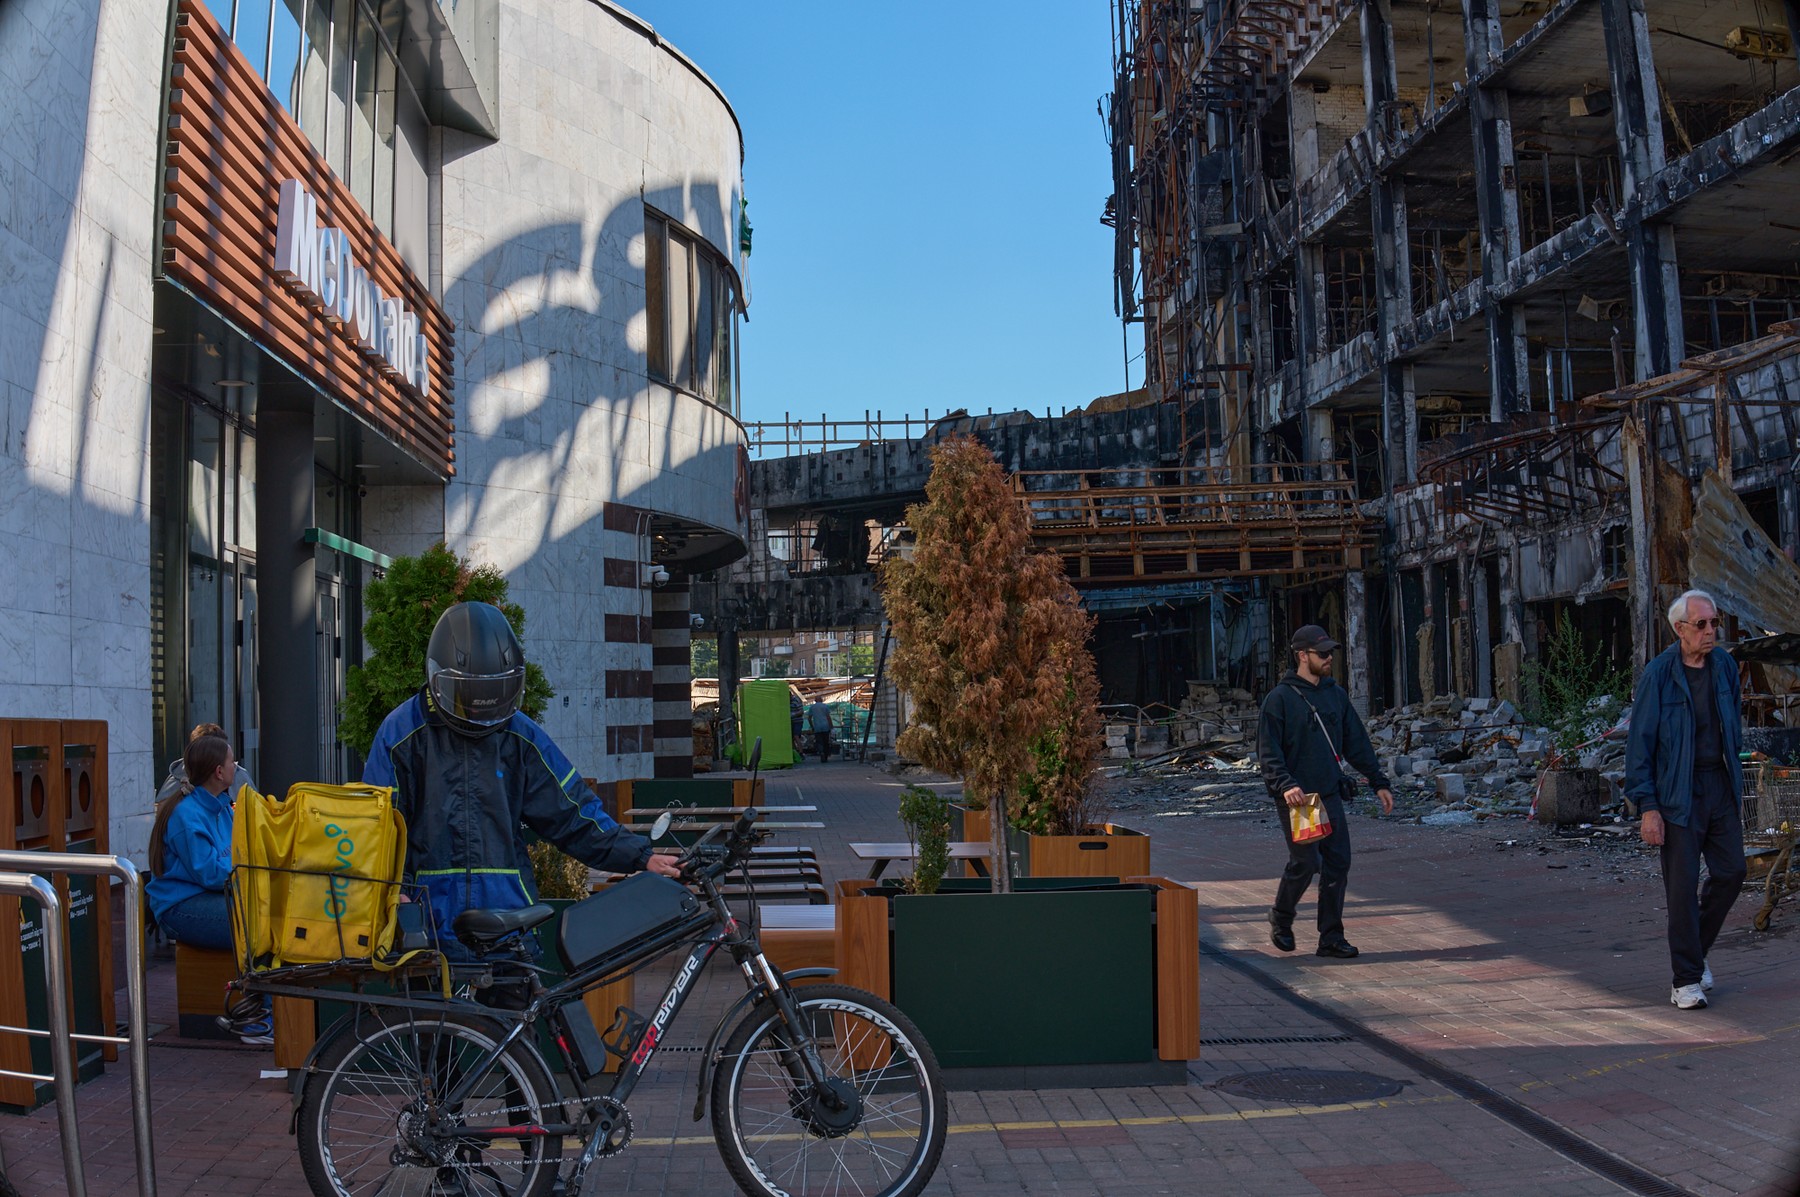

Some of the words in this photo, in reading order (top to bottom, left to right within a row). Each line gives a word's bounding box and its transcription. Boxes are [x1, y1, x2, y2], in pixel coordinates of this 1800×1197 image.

[274, 178, 430, 398] McDonald's
[471, 698, 499, 706] SMK
[323, 837, 355, 919] Glovo
